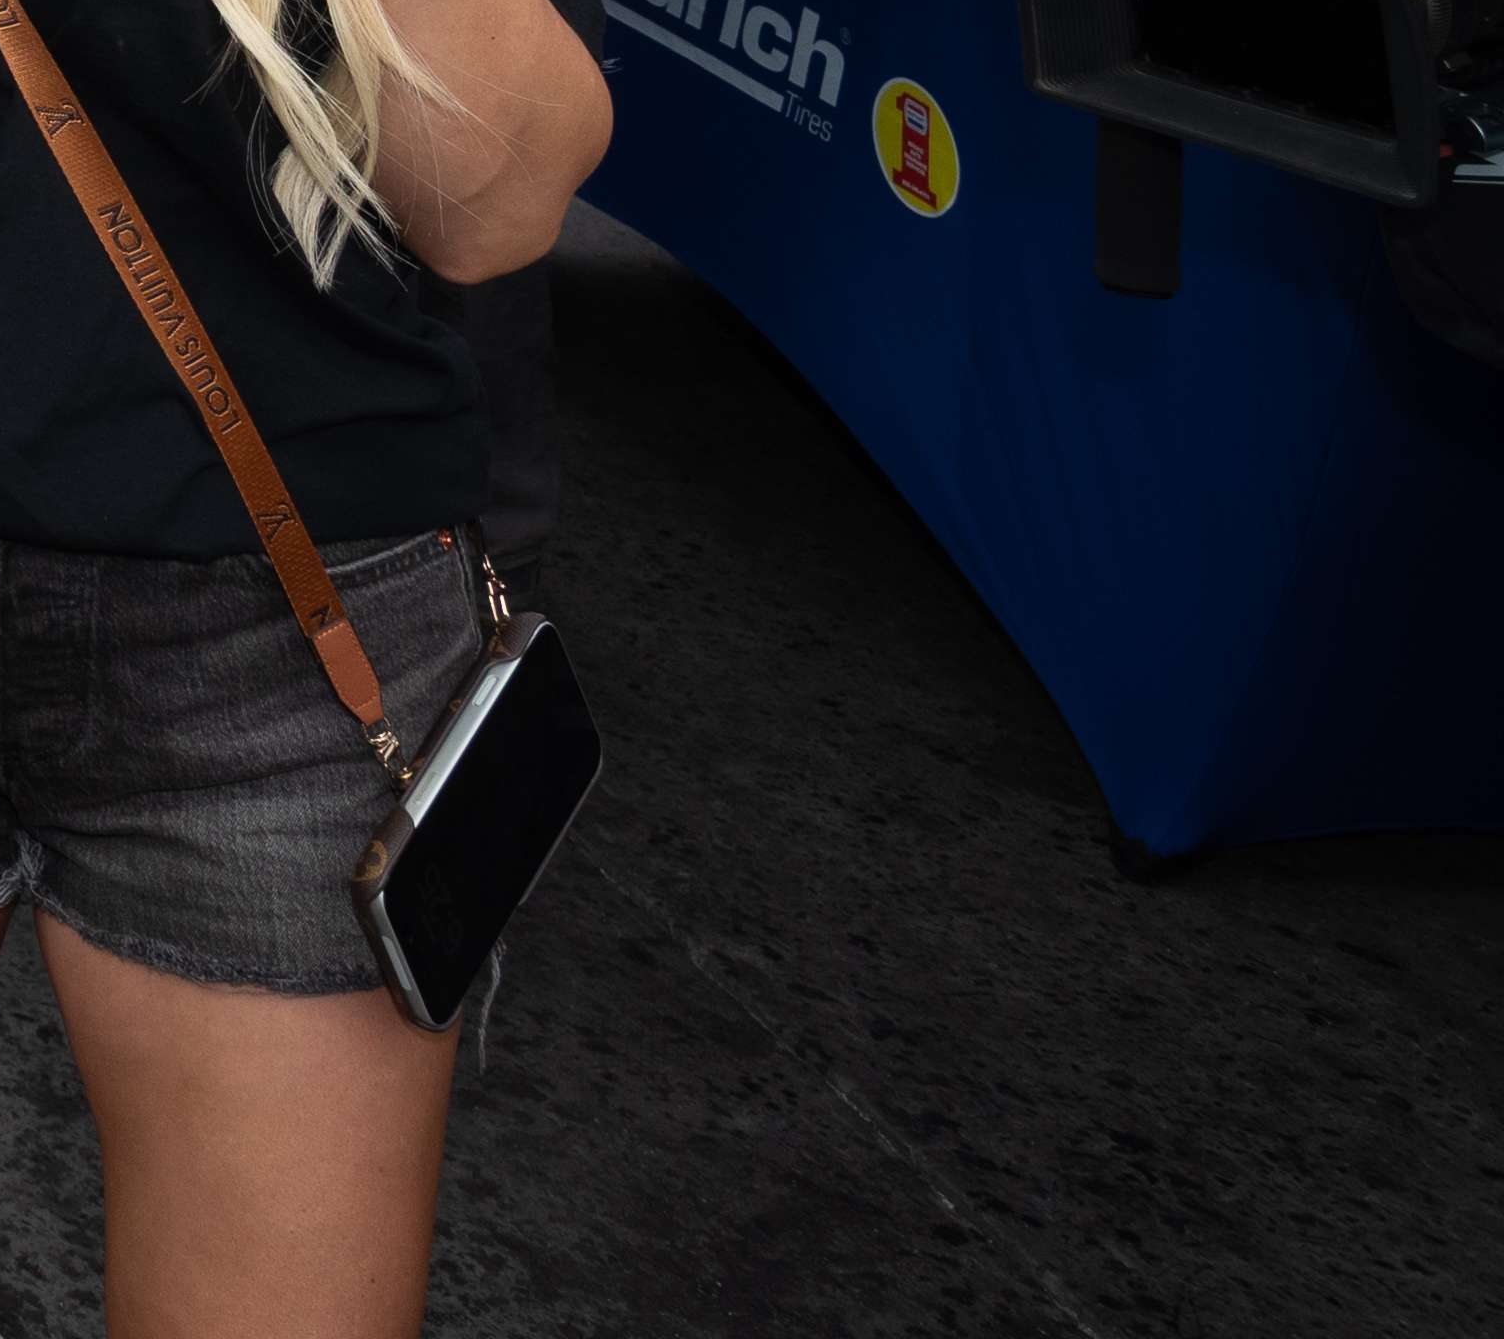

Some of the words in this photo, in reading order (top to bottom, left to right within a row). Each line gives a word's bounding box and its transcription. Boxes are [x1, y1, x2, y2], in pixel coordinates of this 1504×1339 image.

[785, 89, 833, 143] Tires
[97, 200, 188, 340] VUITTON
[174, 328, 240, 436] LOUIS
